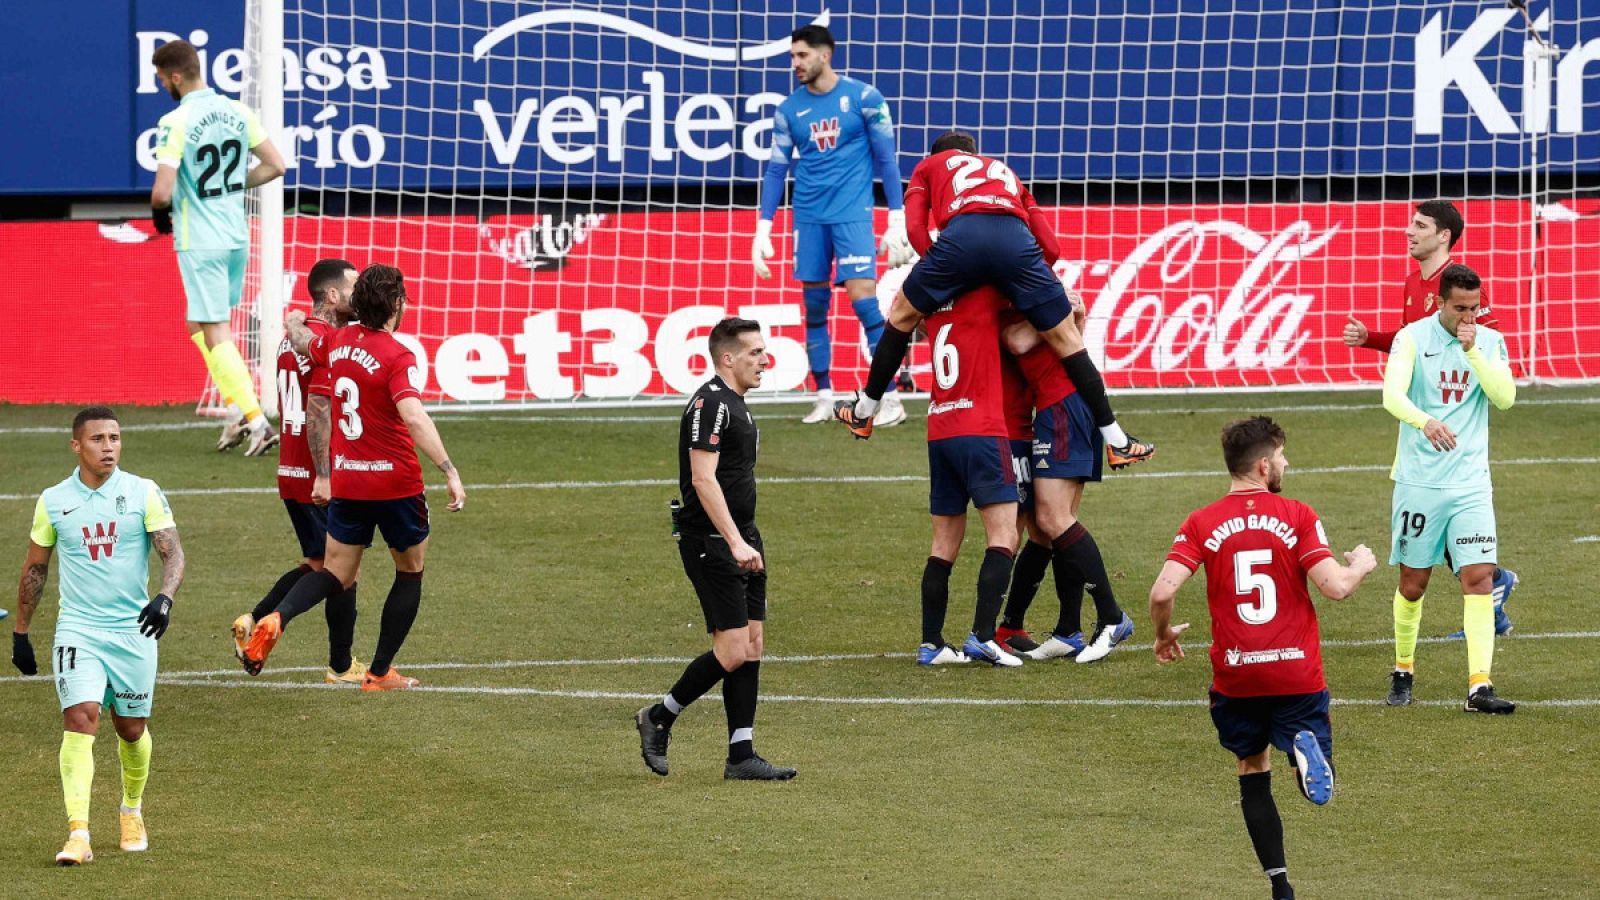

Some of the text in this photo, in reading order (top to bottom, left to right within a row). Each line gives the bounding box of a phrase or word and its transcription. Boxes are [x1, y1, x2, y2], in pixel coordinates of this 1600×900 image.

[274, 105, 386, 169] río
[195, 139, 244, 198] 22
[945, 155, 1018, 197] 24
[348, 304, 809, 401] et365
[350, 346, 381, 375] CRUZ
[933, 323, 960, 390] 6
[278, 368, 306, 436] 14
[335, 376, 364, 440] 3
[1204, 514, 1298, 552] DAVID GARCÍA
[1401, 510, 1426, 539] 19
[1233, 548, 1277, 625] 5
[57, 646, 77, 673] 11
[1243, 653, 1279, 665] VICTORINO
